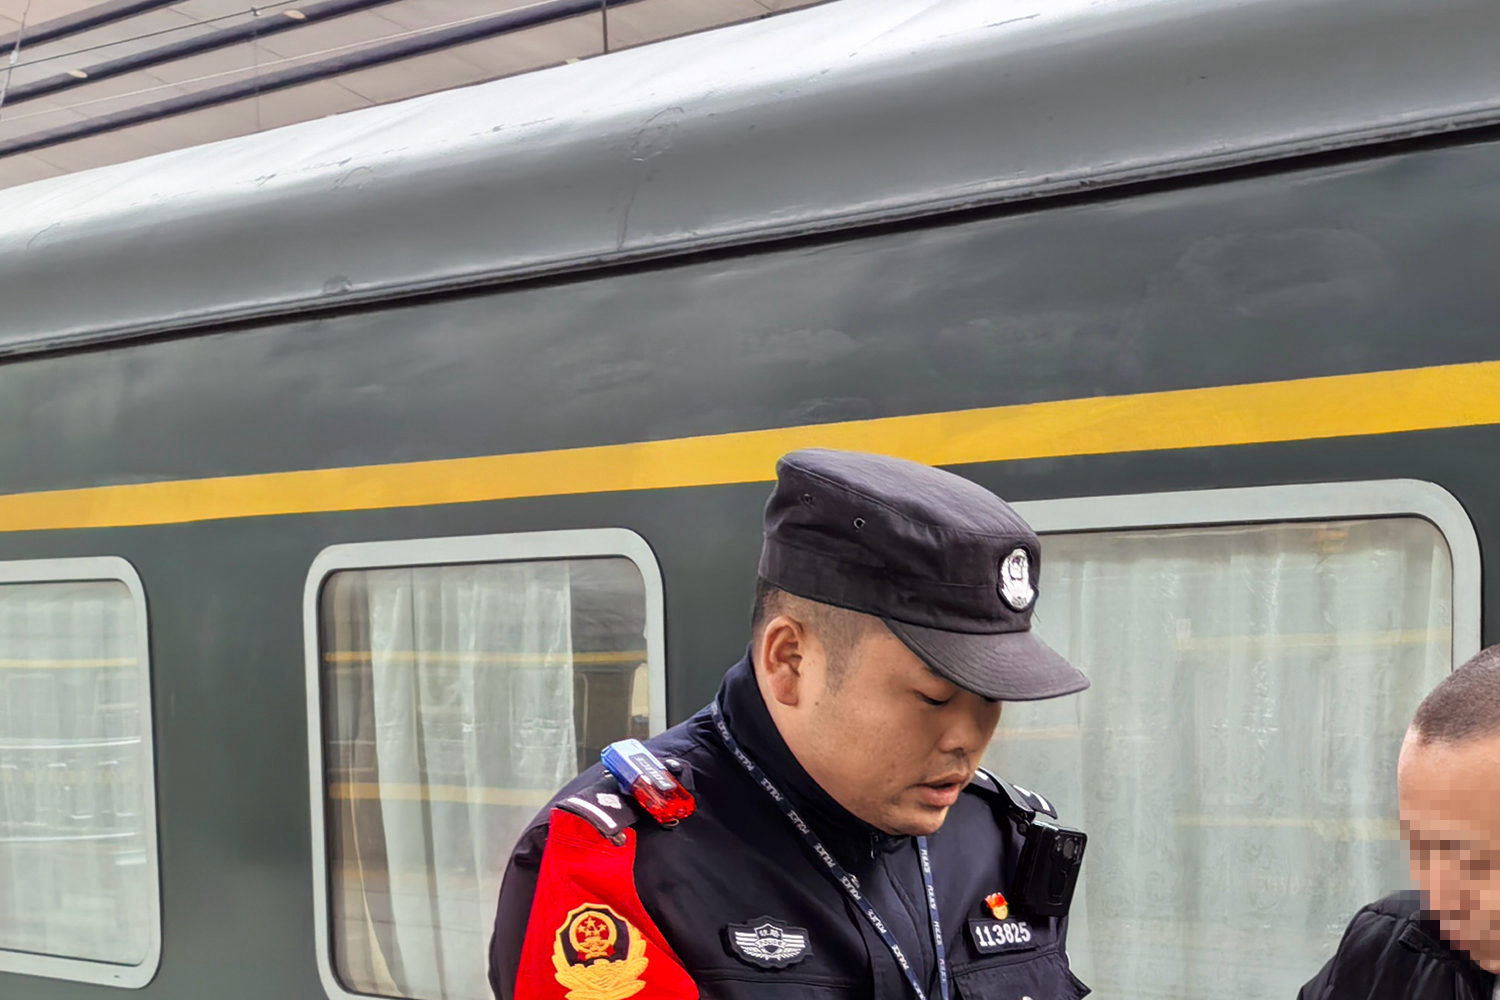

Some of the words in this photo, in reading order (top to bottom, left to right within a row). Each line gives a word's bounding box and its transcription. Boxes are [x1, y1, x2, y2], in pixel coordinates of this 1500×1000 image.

[813, 842, 836, 868] POLICE
[840, 875, 862, 901] POLICE
[866, 908, 887, 934] POLICE
[975, 921, 1032, 947] 113825
